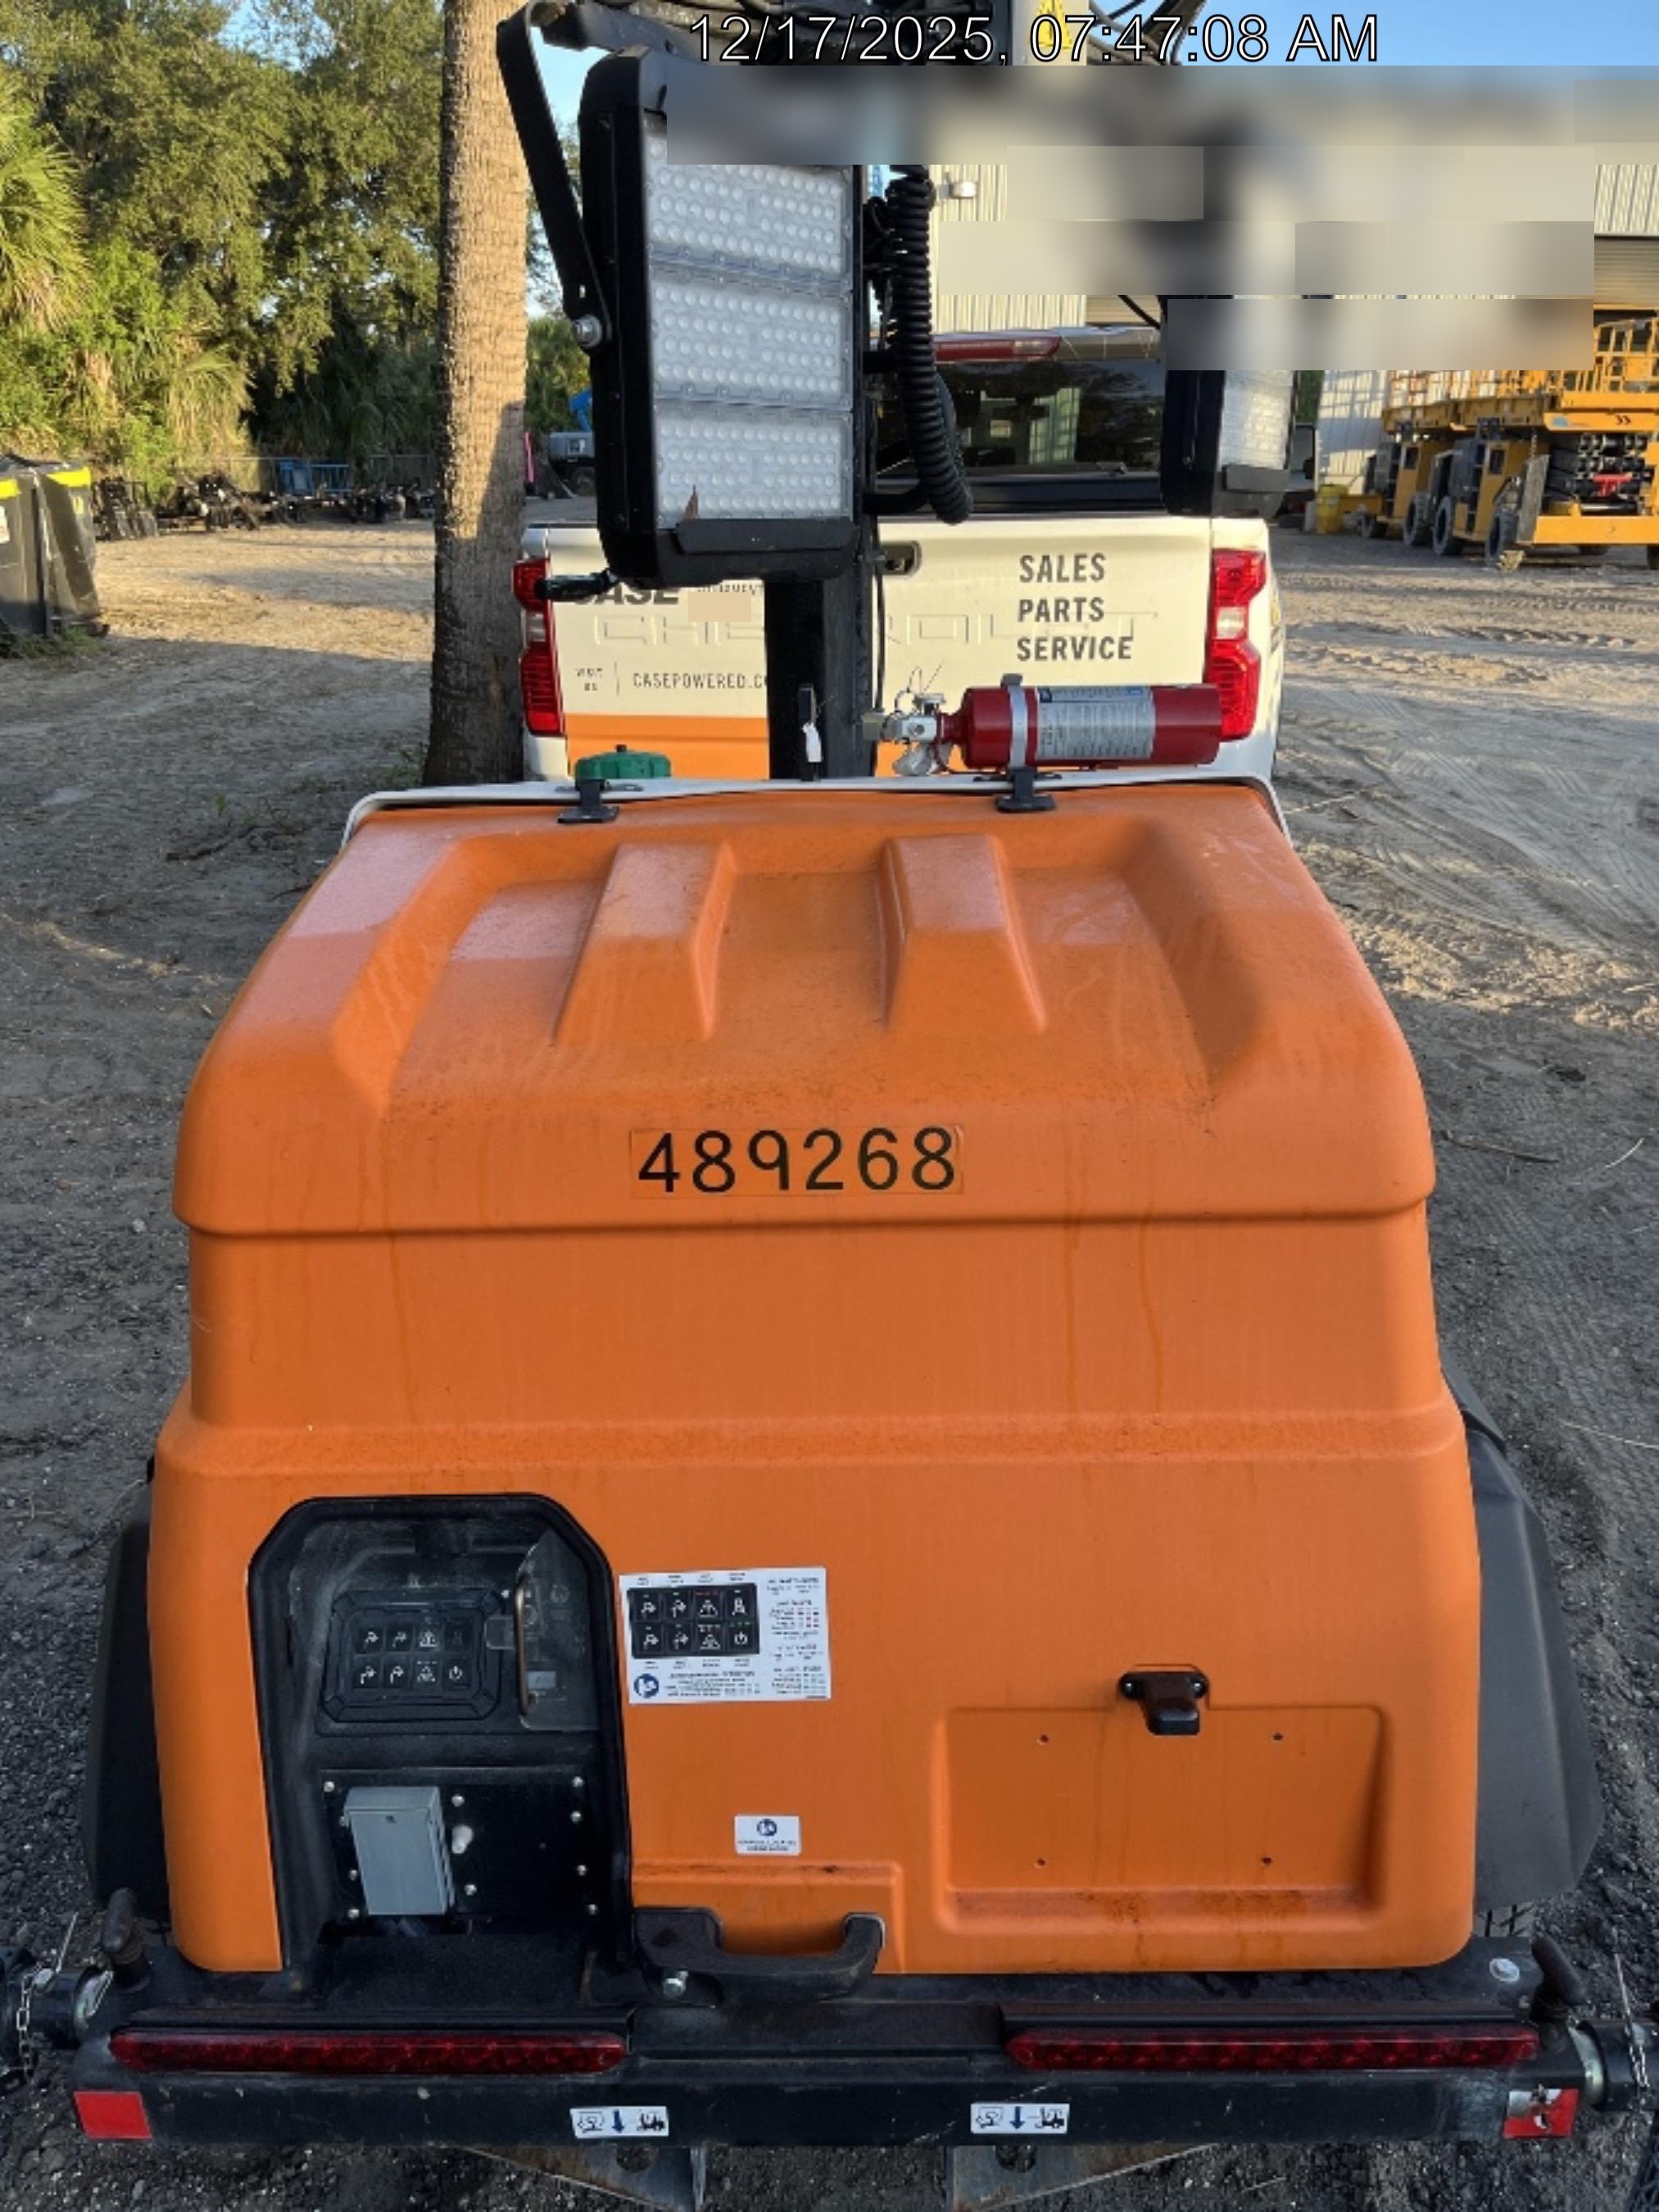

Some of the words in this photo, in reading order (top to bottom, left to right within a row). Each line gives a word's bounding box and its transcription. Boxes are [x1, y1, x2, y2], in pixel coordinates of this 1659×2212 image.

[1019, 553, 1107, 582] SALES
[573, 583, 679, 605] ASE
[1018, 597, 1104, 623] PARTS
[1017, 636, 1133, 661] SERVICE
[638, 1126, 955, 1194] 489268
